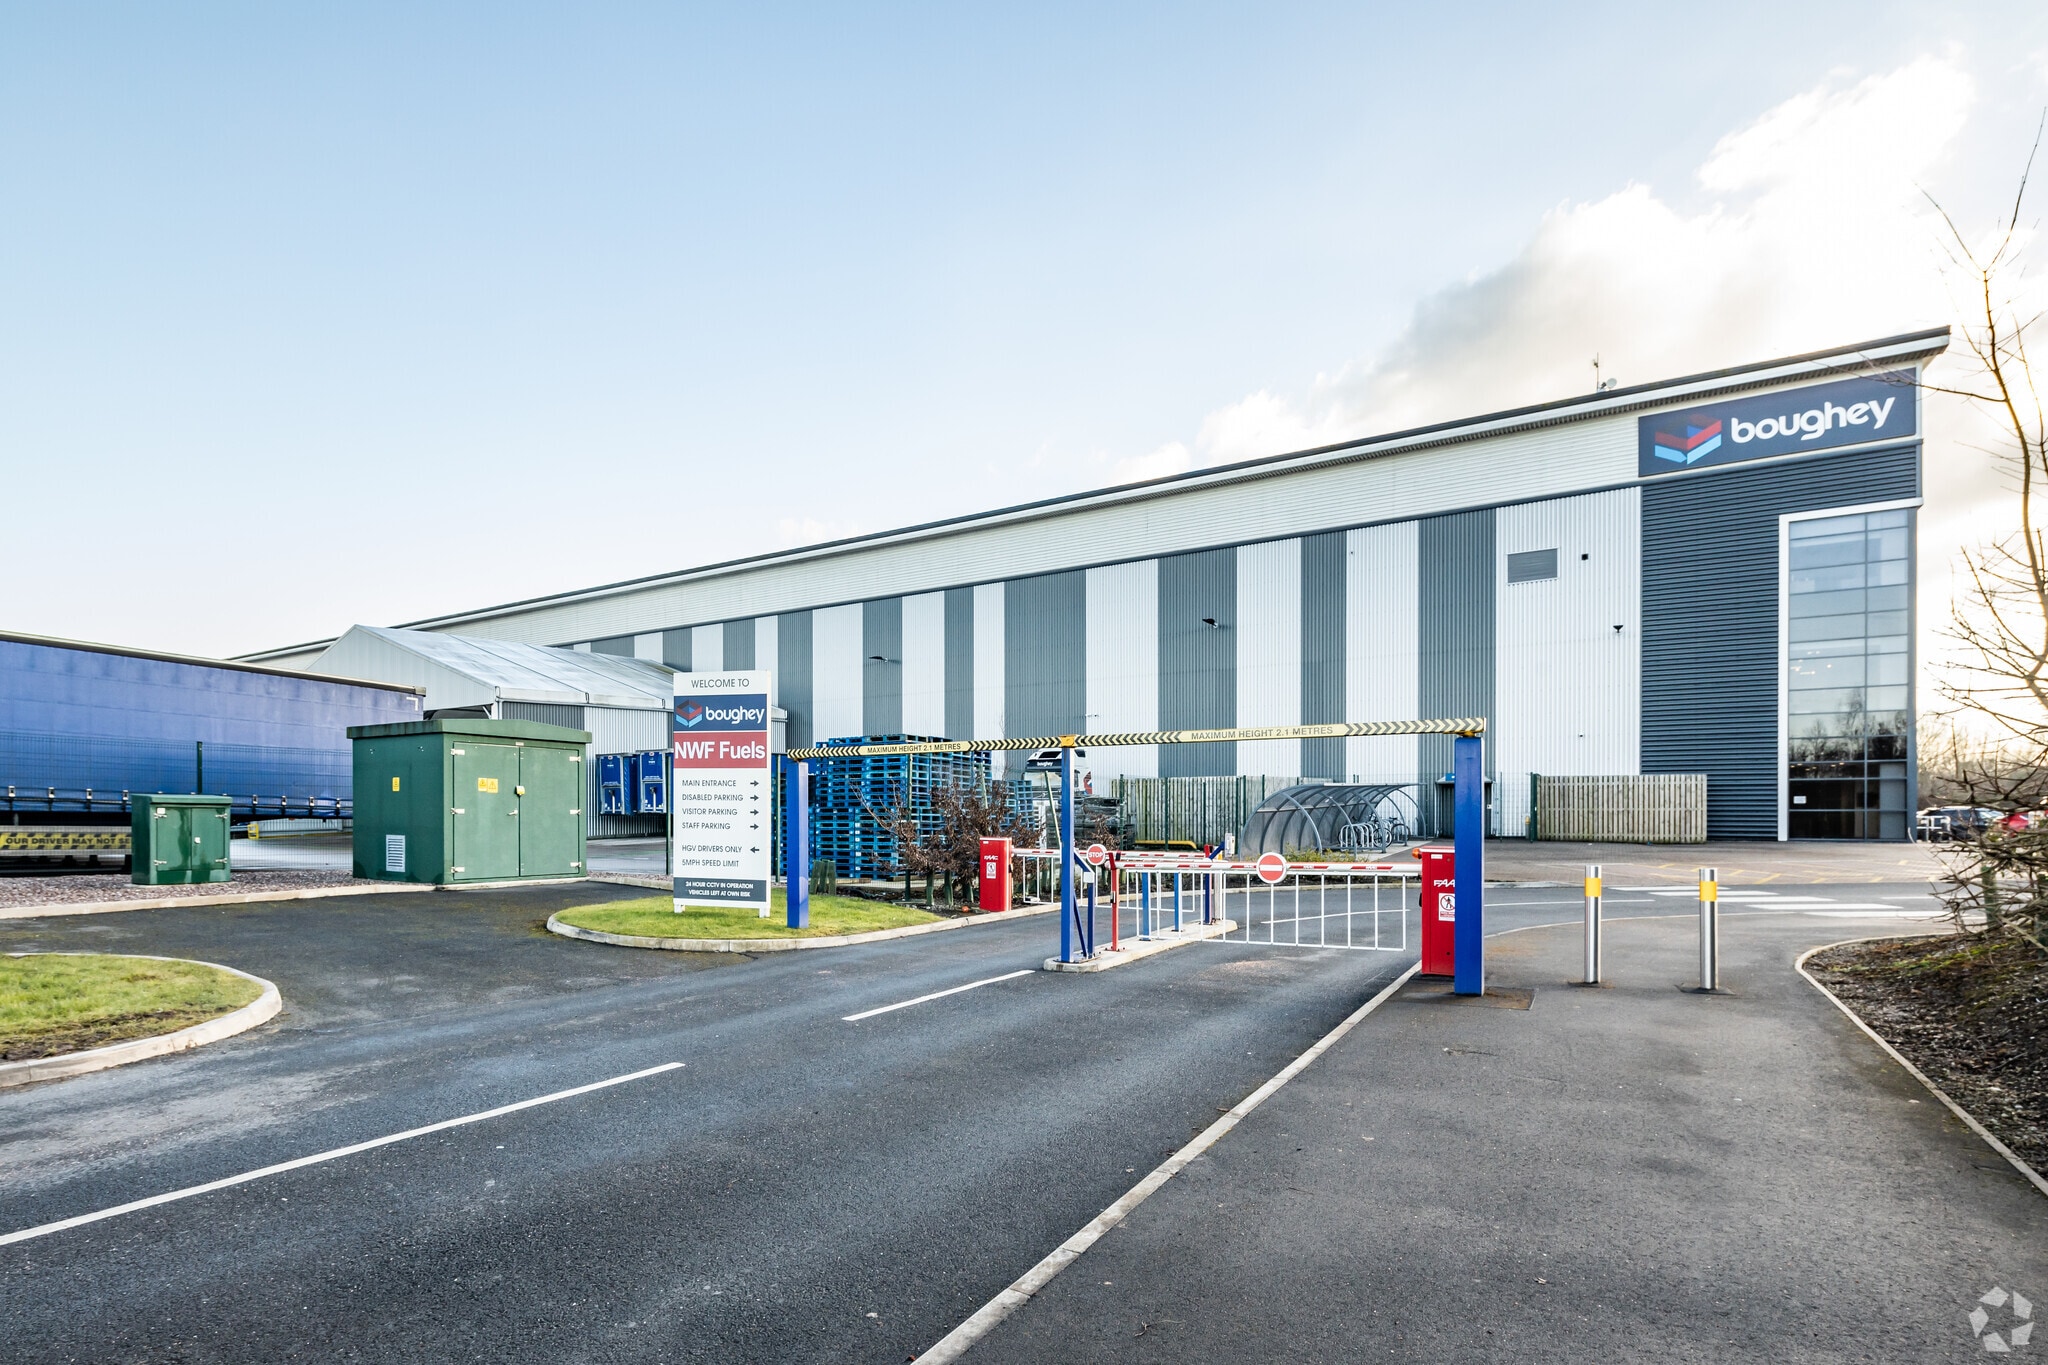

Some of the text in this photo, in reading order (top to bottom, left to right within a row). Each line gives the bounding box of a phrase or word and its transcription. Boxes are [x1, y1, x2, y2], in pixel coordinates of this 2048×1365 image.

[1731, 397, 1896, 444] boughey
[691, 678, 750, 688] WELCOME TO
[706, 706, 765, 724] boughey
[1191, 726, 1333, 740] MAXIMUM HEIGHT 2.1 METRES
[675, 741, 766, 760] NWF Fuels
[1434, 878, 1456, 888] FAA
